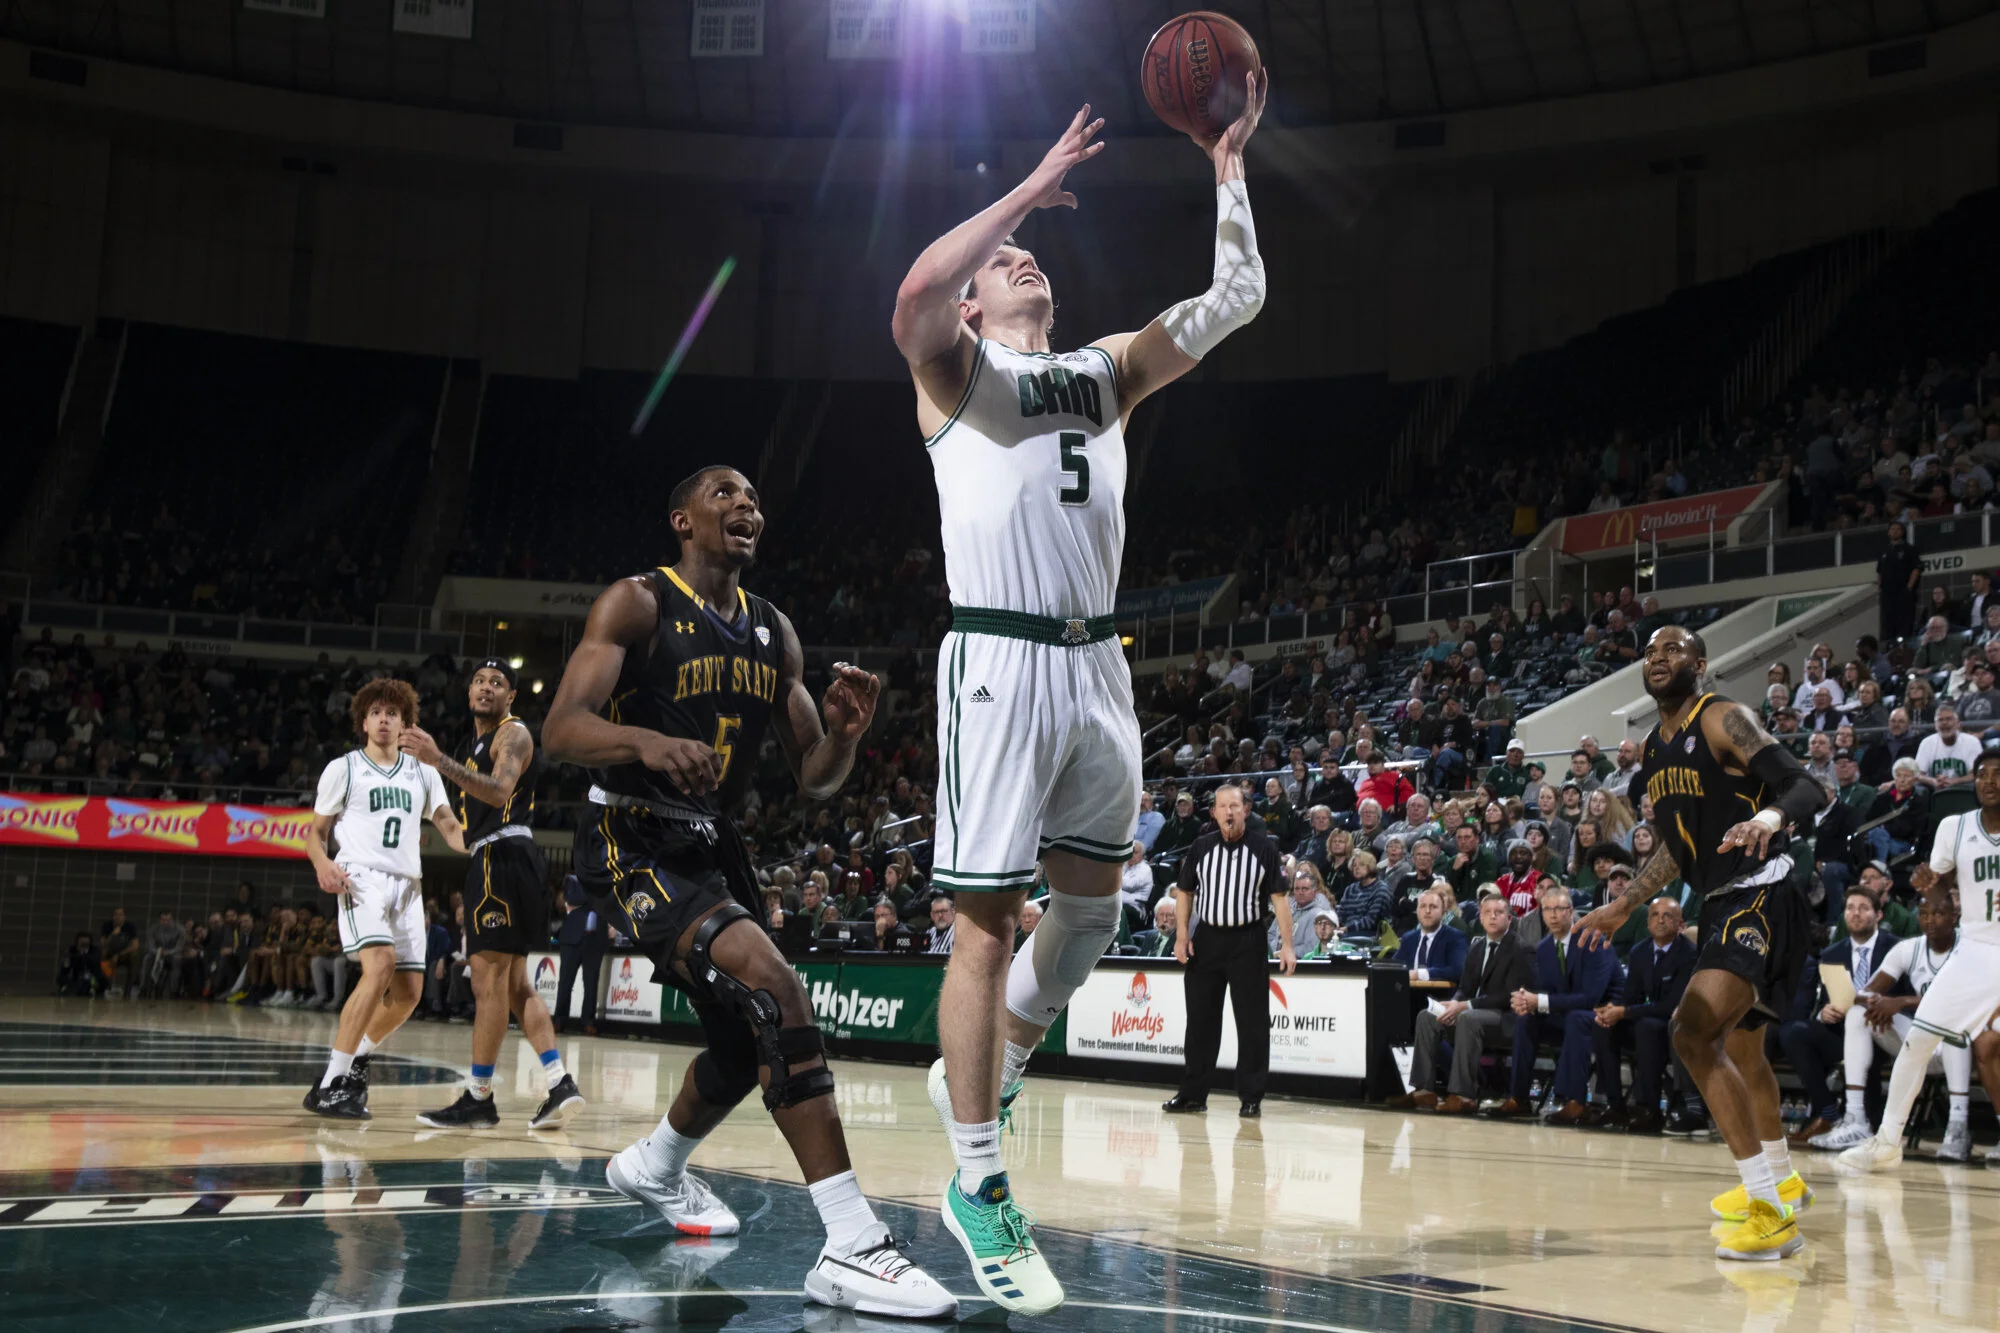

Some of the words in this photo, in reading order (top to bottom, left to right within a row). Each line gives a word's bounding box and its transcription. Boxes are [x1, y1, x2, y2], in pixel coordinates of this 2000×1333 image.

[1187, 38, 1213, 121] Wilson
[1017, 367, 1103, 427] OHIO
[1058, 429, 1091, 507] 5
[673, 654, 727, 703] KENT
[970, 695, 995, 703] adidas
[711, 712, 743, 785] 5
[1667, 766, 1705, 796] STATE
[369, 786, 412, 814] OHIO
[113, 811, 198, 835] SONIC
[382, 816, 402, 849] 0
[539, 979, 556, 990] DAVID
[610, 983, 639, 1007] Wendy's
[811, 981, 904, 1028] Holzer
[1111, 1006, 1164, 1040] Wendy's
[1294, 1015, 1336, 1032] WHITE
[1078, 1037, 1096, 1049] Three
[1097, 1038, 1134, 1051] Convenient
[1135, 1042, 1158, 1053] Athens
